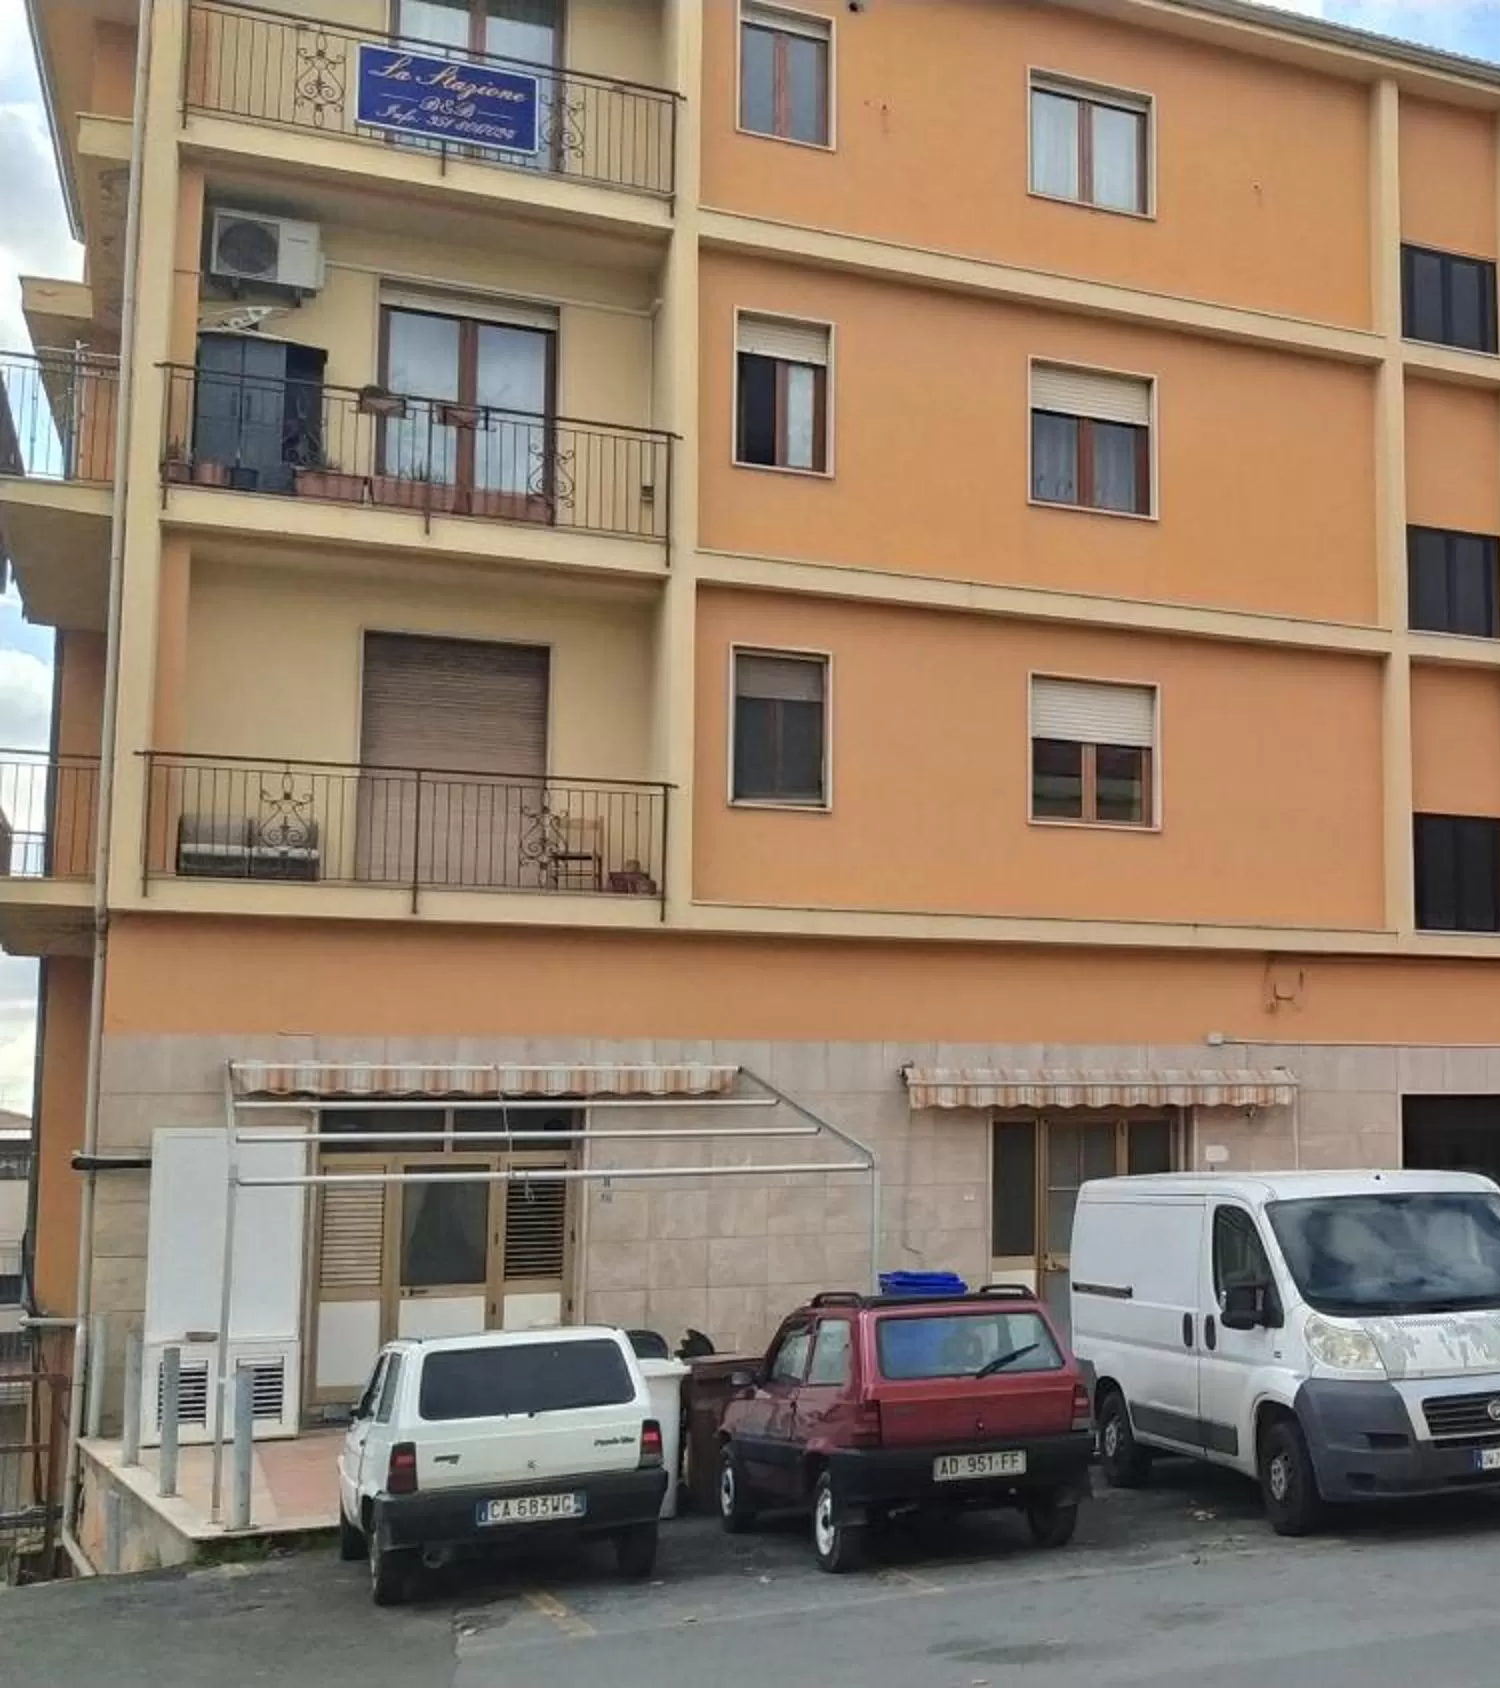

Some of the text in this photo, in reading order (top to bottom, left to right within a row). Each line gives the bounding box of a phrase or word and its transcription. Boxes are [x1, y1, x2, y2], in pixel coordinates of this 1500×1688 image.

[368, 56, 526, 102] La Stazione
[939, 1457, 959, 1475] AD
[967, 1454, 994, 1473] 951
[490, 1500, 511, 1519] CA
